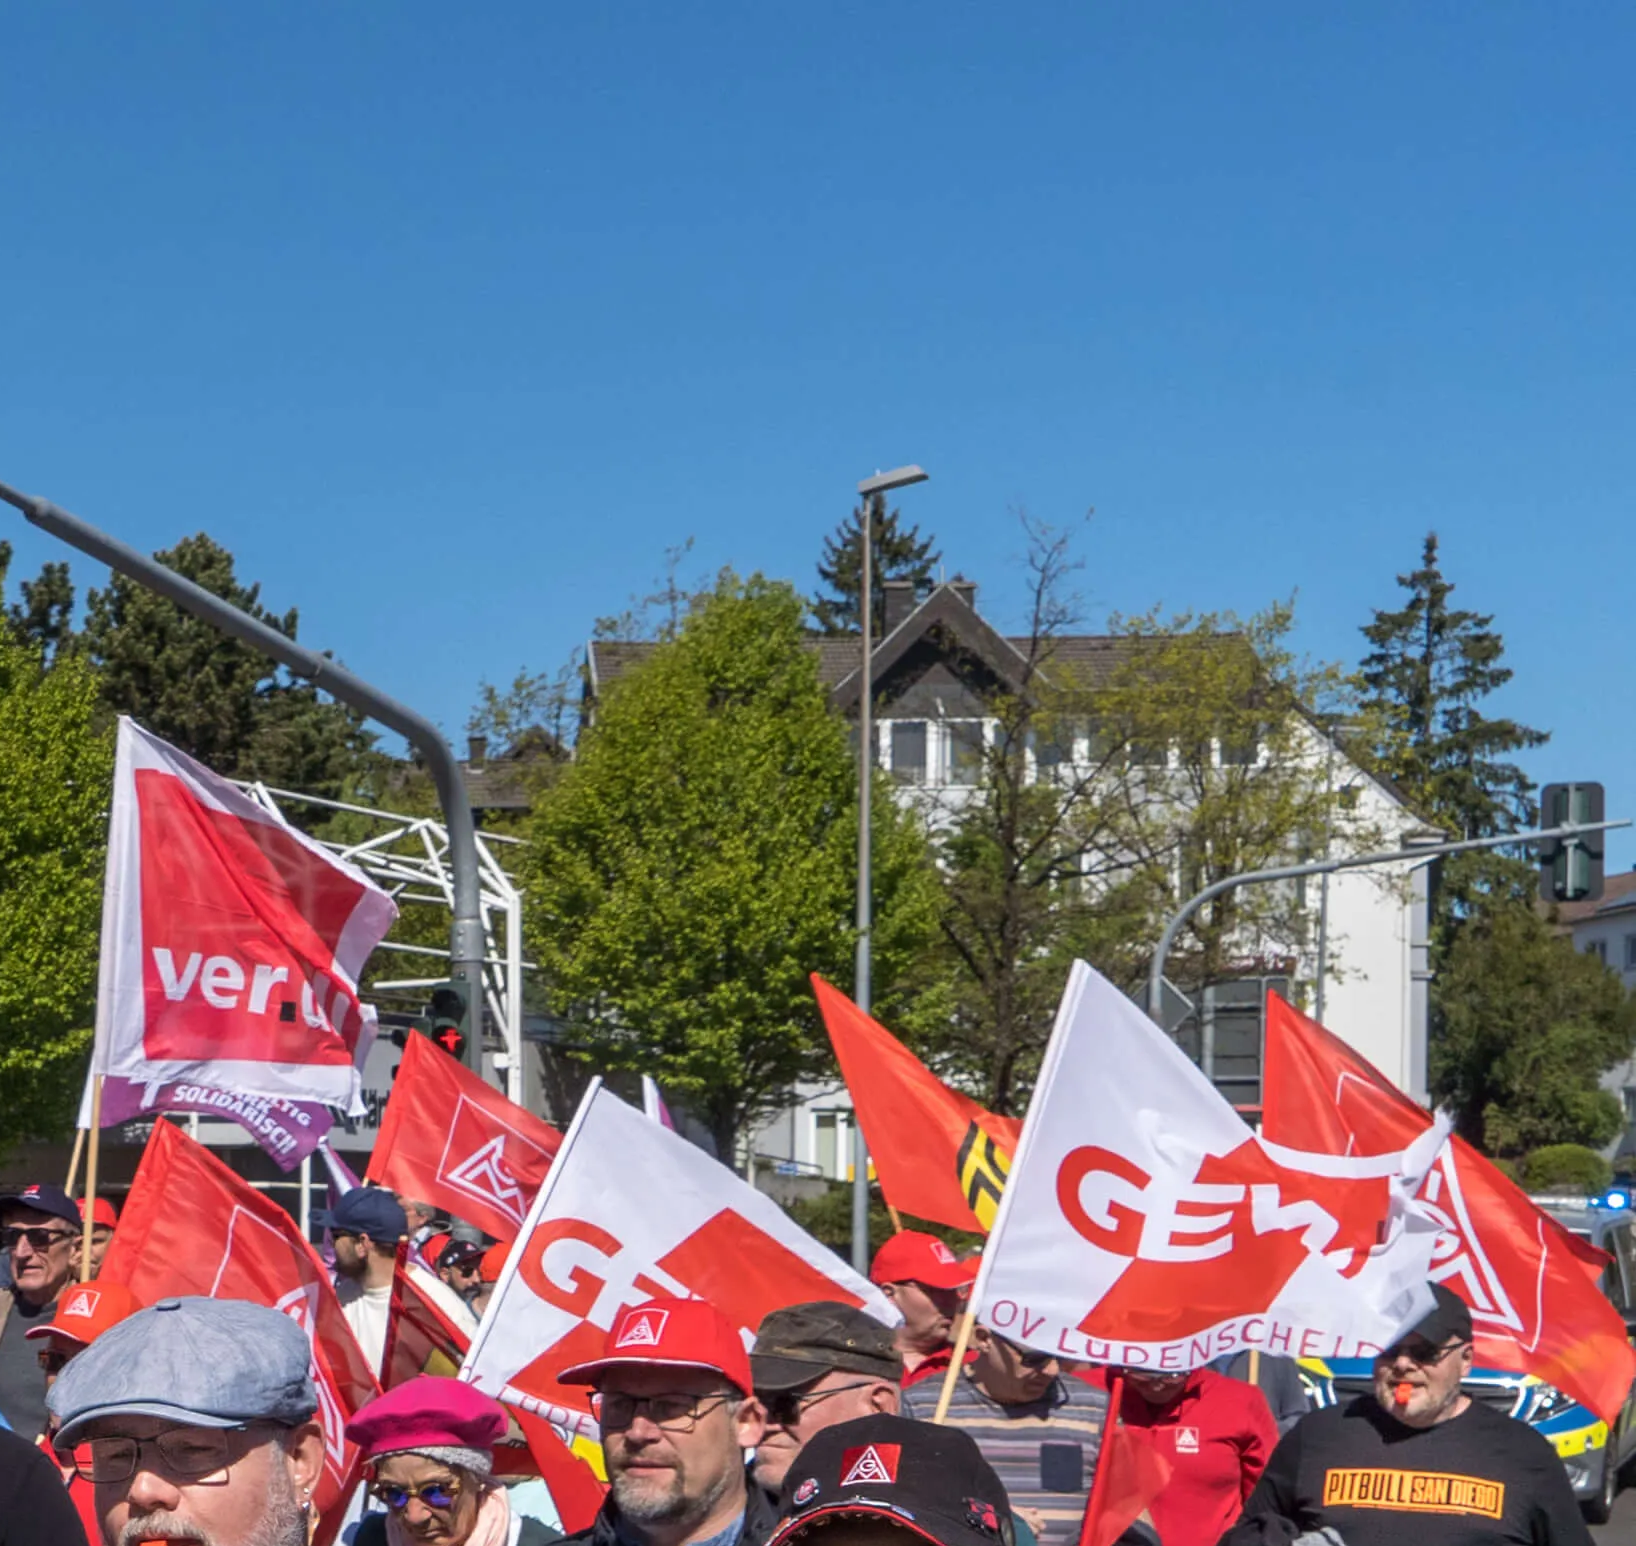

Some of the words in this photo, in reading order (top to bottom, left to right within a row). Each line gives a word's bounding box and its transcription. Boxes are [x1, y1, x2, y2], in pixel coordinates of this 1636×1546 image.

[991, 1299, 1046, 1340] OV
[1329, 1472, 1406, 1503] PITBULL
[1412, 1477, 1449, 1504] SAN
[1450, 1480, 1497, 1512] DIEGO
